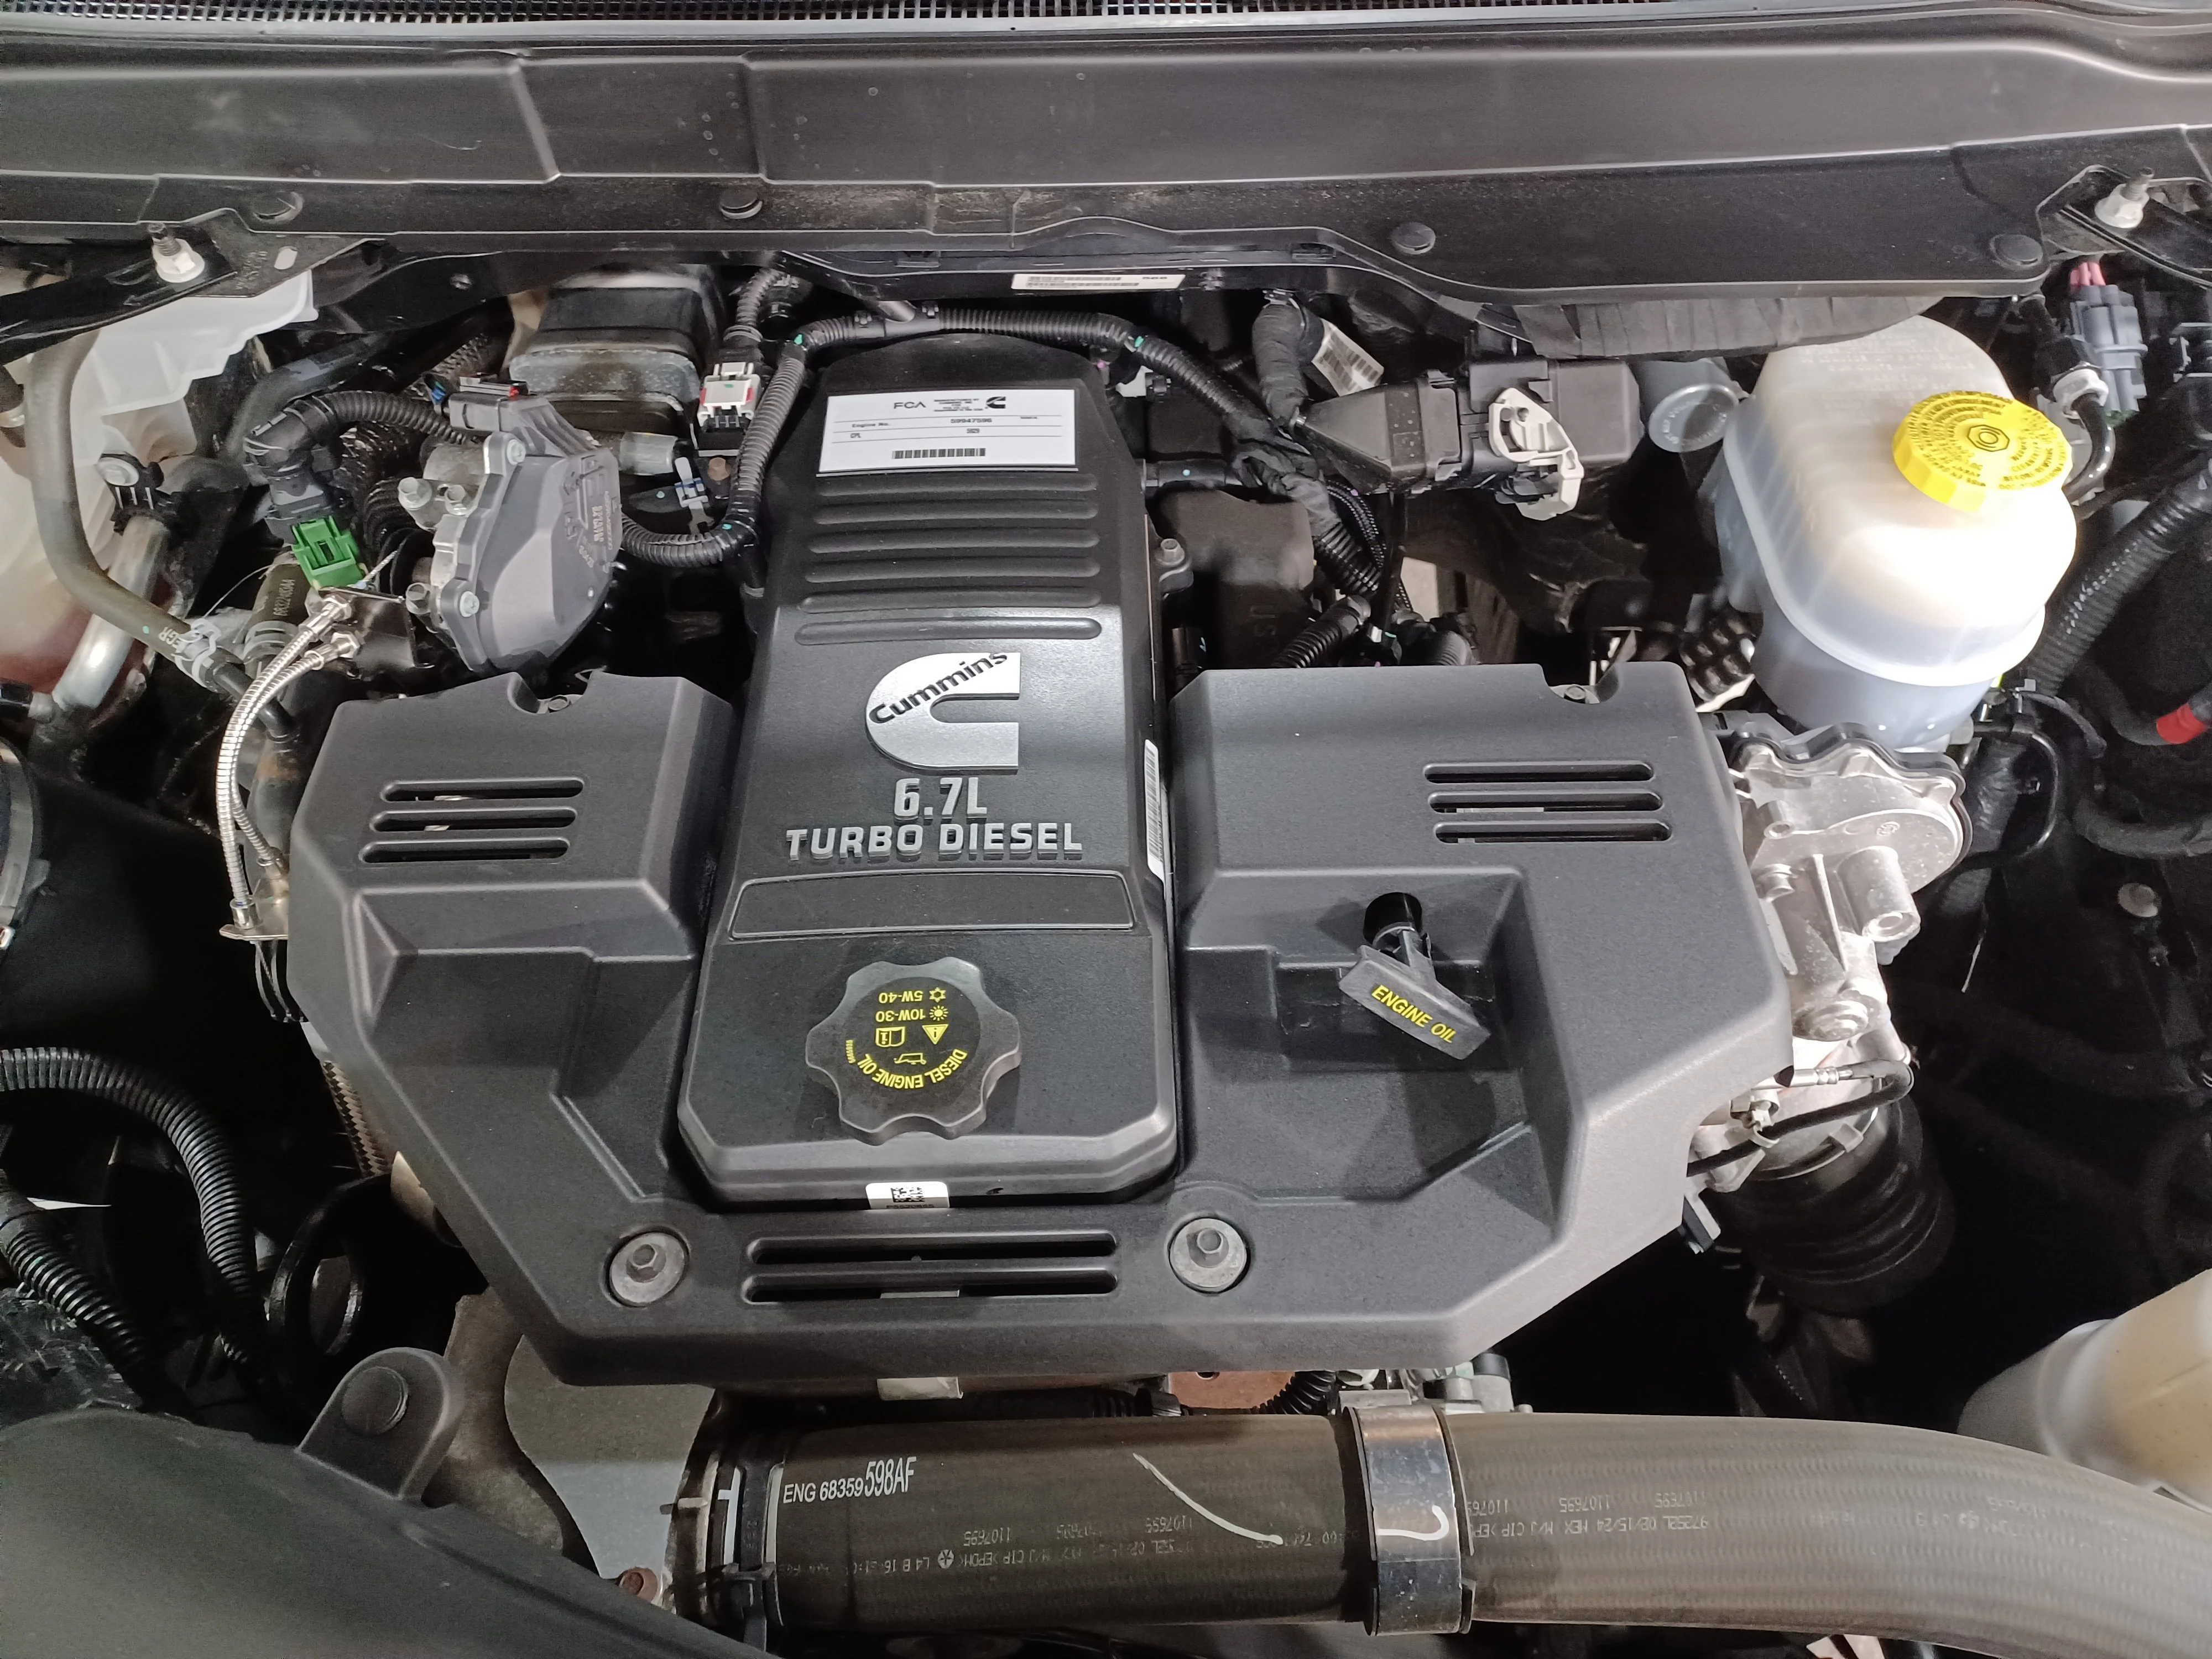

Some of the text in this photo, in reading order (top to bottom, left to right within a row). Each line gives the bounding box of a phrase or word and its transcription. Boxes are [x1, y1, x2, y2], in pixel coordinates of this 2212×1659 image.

[894, 401, 926, 409] FCA
[894, 777, 988, 820] 6.7L
[786, 822, 1083, 860] TURBO DIESEL
[878, 990, 924, 1004] 5W-40
[875, 1009, 926, 1022] 10W-30
[1371, 984, 1457, 1044] ENGINE OIL
[857, 1048, 968, 1089] DIESEL ENGINE OIL
[783, 1483, 817, 1504] ENG
[1564, 1519, 1588, 1535] MEX
